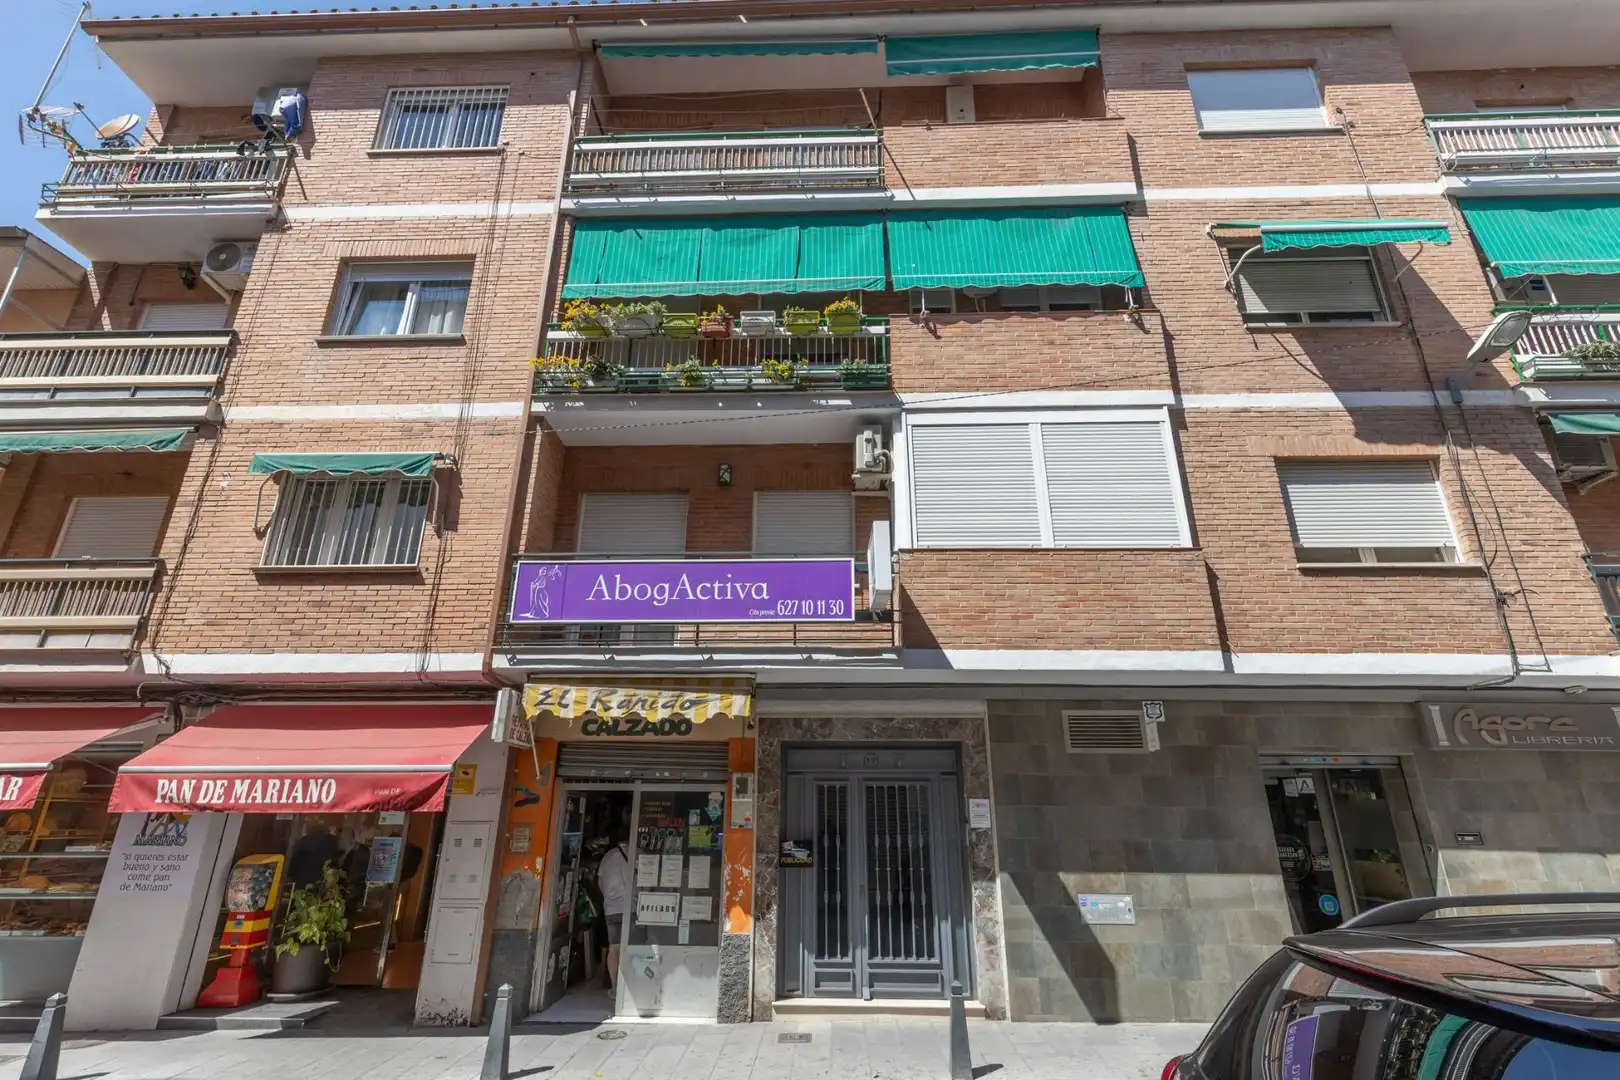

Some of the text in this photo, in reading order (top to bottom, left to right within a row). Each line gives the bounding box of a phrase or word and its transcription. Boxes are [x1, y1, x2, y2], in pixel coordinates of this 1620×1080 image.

[586, 573, 770, 606] AbogActiva
[777, 599, 798, 616] 627
[801, 599, 814, 616] 10
[817, 599, 826, 616] 11
[828, 599, 844, 616] 30
[580, 715, 693, 736] CALZADO
[155, 778, 337, 805] PAN DE MARIANO
[133, 853, 165, 862] quieres
[167, 853, 189, 862] estar
[122, 862, 181, 873] bueno y sano
[127, 873, 171, 883] come pan
[119, 882, 132, 892] de
